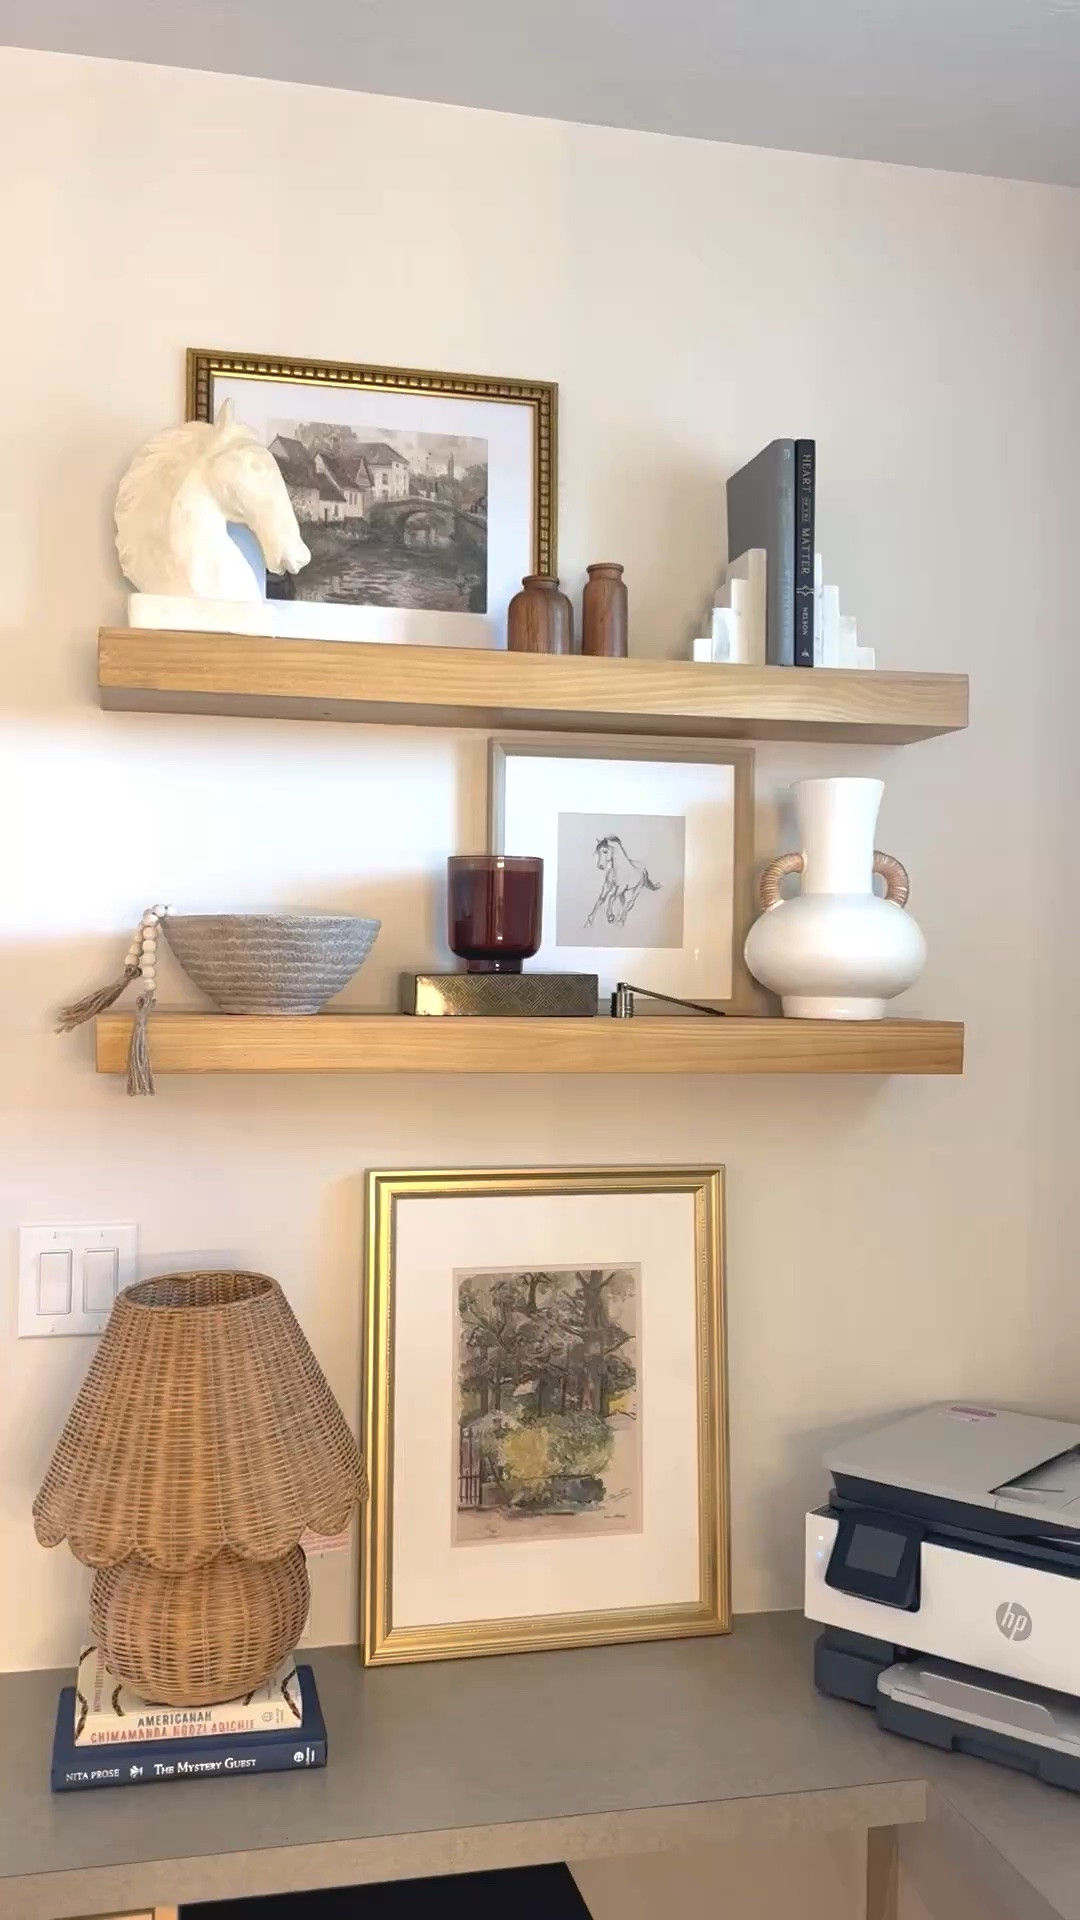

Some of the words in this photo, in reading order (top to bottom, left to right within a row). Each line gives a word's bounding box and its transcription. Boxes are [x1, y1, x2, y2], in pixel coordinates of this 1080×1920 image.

[802, 454, 812, 493] HEART
[801, 527, 811, 576] MATTER
[1001, 1602, 1028, 1640] hp
[91, 1725, 168, 1744] CHIMAMANDA
[211, 1719, 254, 1733] ADICHIE
[137, 1711, 212, 1728] AMERICANAH
[65, 1772, 89, 1782] NITA
[91, 1768, 120, 1780] PROSE
